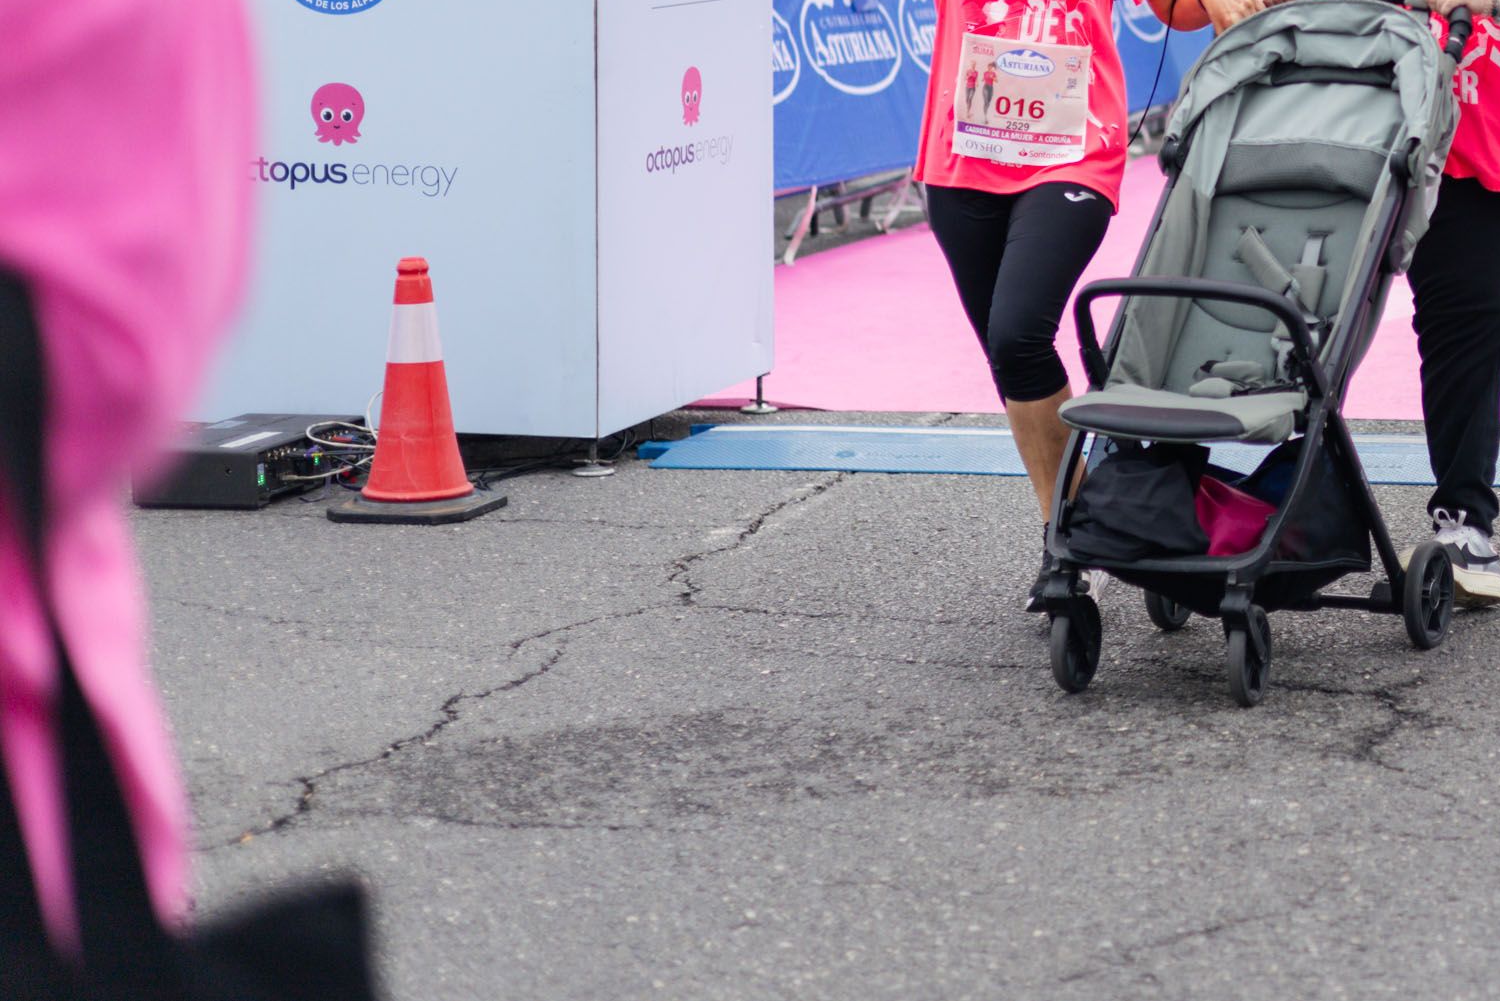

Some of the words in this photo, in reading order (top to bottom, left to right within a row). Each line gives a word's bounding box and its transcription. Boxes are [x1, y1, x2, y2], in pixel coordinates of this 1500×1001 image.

[330, 1, 349, 10] LOS
[810, 19, 897, 68] ASTURIANA
[1000, 56, 1051, 74] ASTURIANA
[995, 96, 1045, 120] 016
[991, 128, 999, 138] DE
[1001, 130, 1010, 139] LA
[1006, 120, 1030, 131] 2529
[965, 139, 1003, 154] OYSHO
[646, 143, 695, 175] octopus
[1029, 150, 1069, 160] Santander
[249, 156, 348, 190] topus
[352, 163, 458, 197] energy
